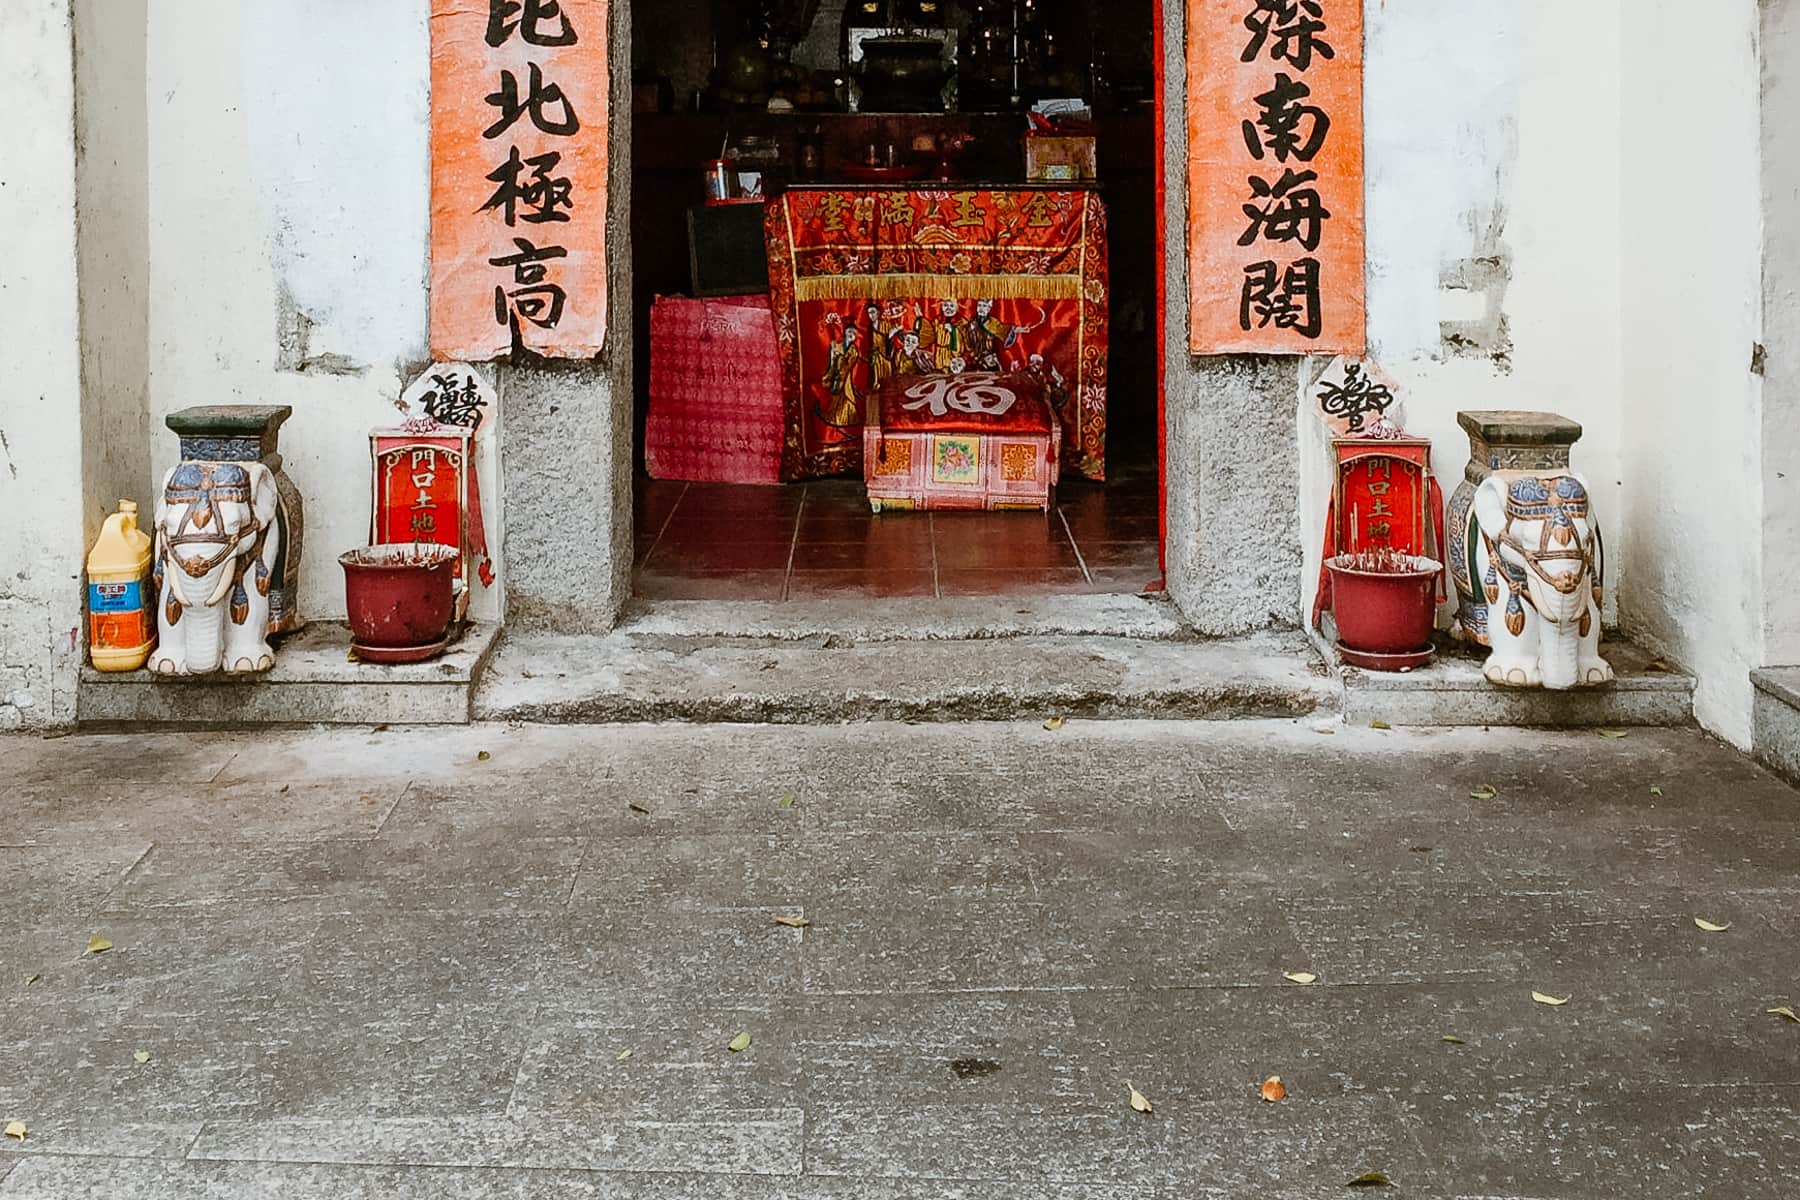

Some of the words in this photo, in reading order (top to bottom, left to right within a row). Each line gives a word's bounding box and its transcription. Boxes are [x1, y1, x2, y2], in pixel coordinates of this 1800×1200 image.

[902, 373, 1017, 417] 福
[410, 448, 438, 544] 門口土地
[1366, 457, 1393, 552] 門口土地
